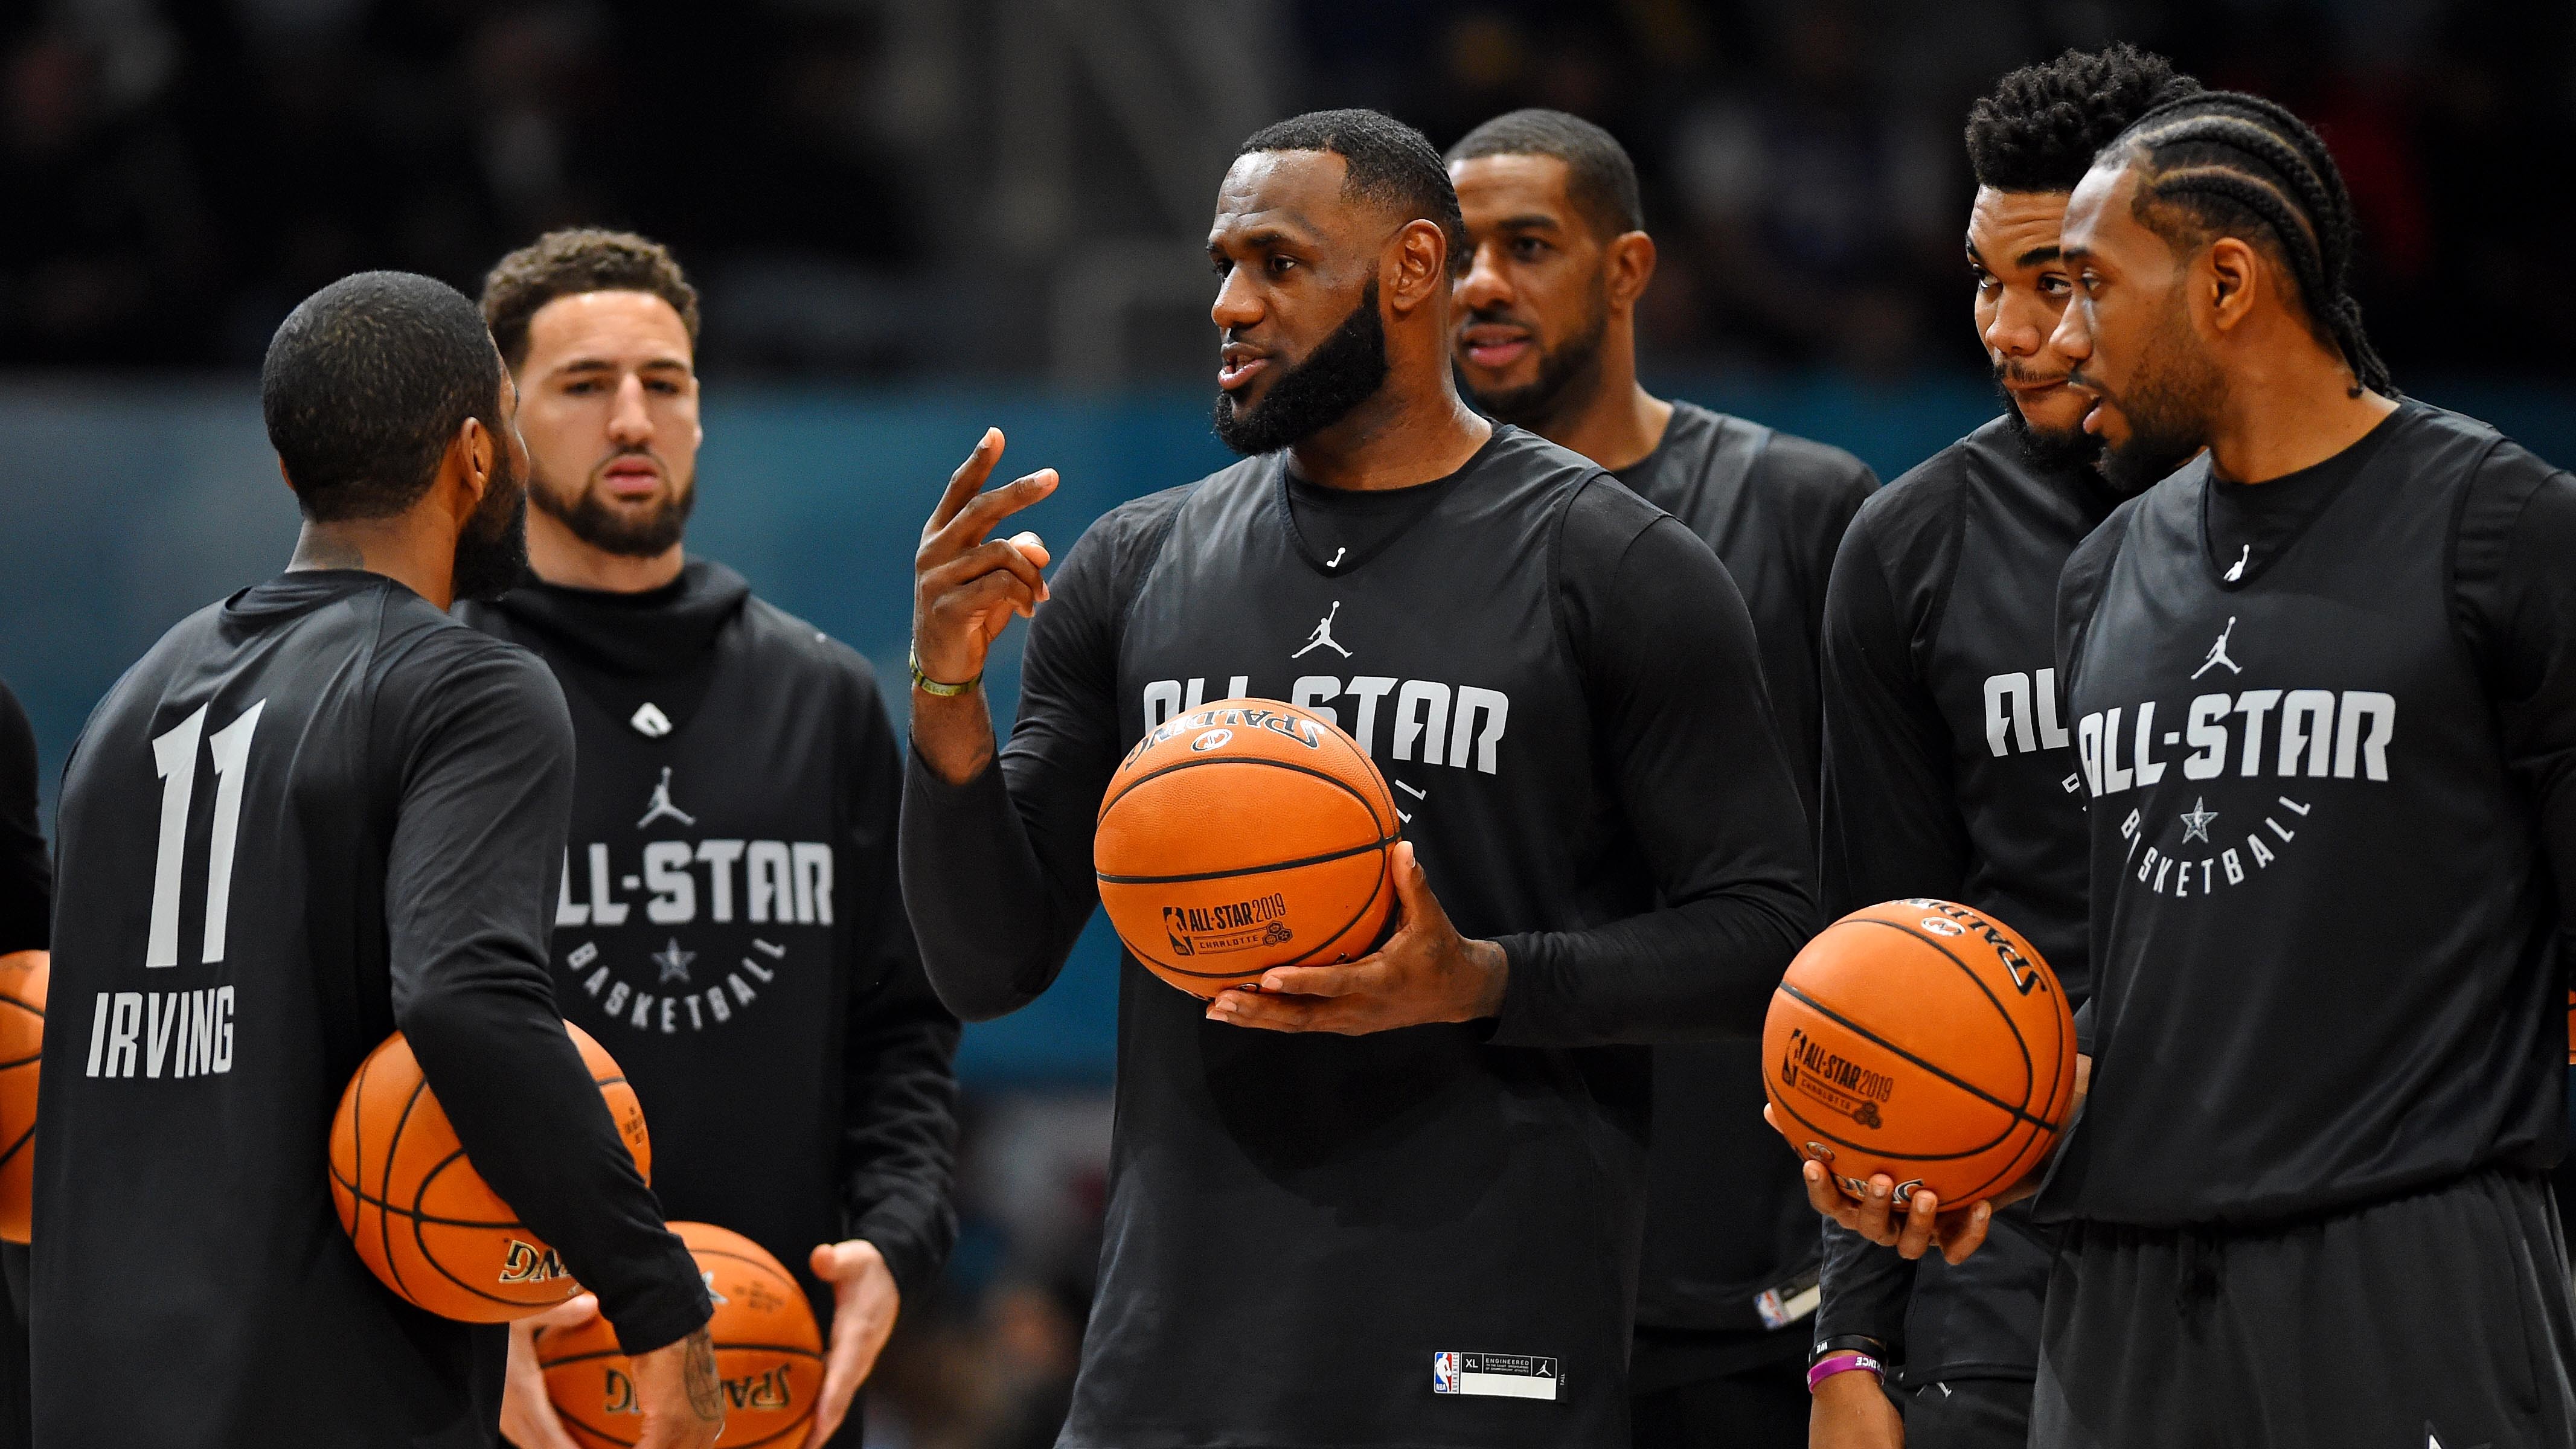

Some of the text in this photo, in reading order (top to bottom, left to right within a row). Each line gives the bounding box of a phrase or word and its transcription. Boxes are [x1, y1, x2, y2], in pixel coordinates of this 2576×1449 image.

[1124, 708, 1325, 772] SPALDING
[1143, 676, 1509, 775] ASTAR
[2078, 689, 2396, 798] ALL-STAR
[146, 697, 266, 968] 11
[555, 839, 833, 926] LL-STAR
[1251, 892, 1286, 923] 2019
[1199, 935, 1258, 948] CHARLOTTE
[566, 938, 786, 1034] BASKETBALL
[86, 985, 234, 1078] IRVING
[1859, 1069, 1894, 1103] 2019
[1465, 1358, 1479, 1368] XL
[1485, 1357, 1530, 1366] ENGINEERED
[1816, 1341, 1828, 1354] WE
